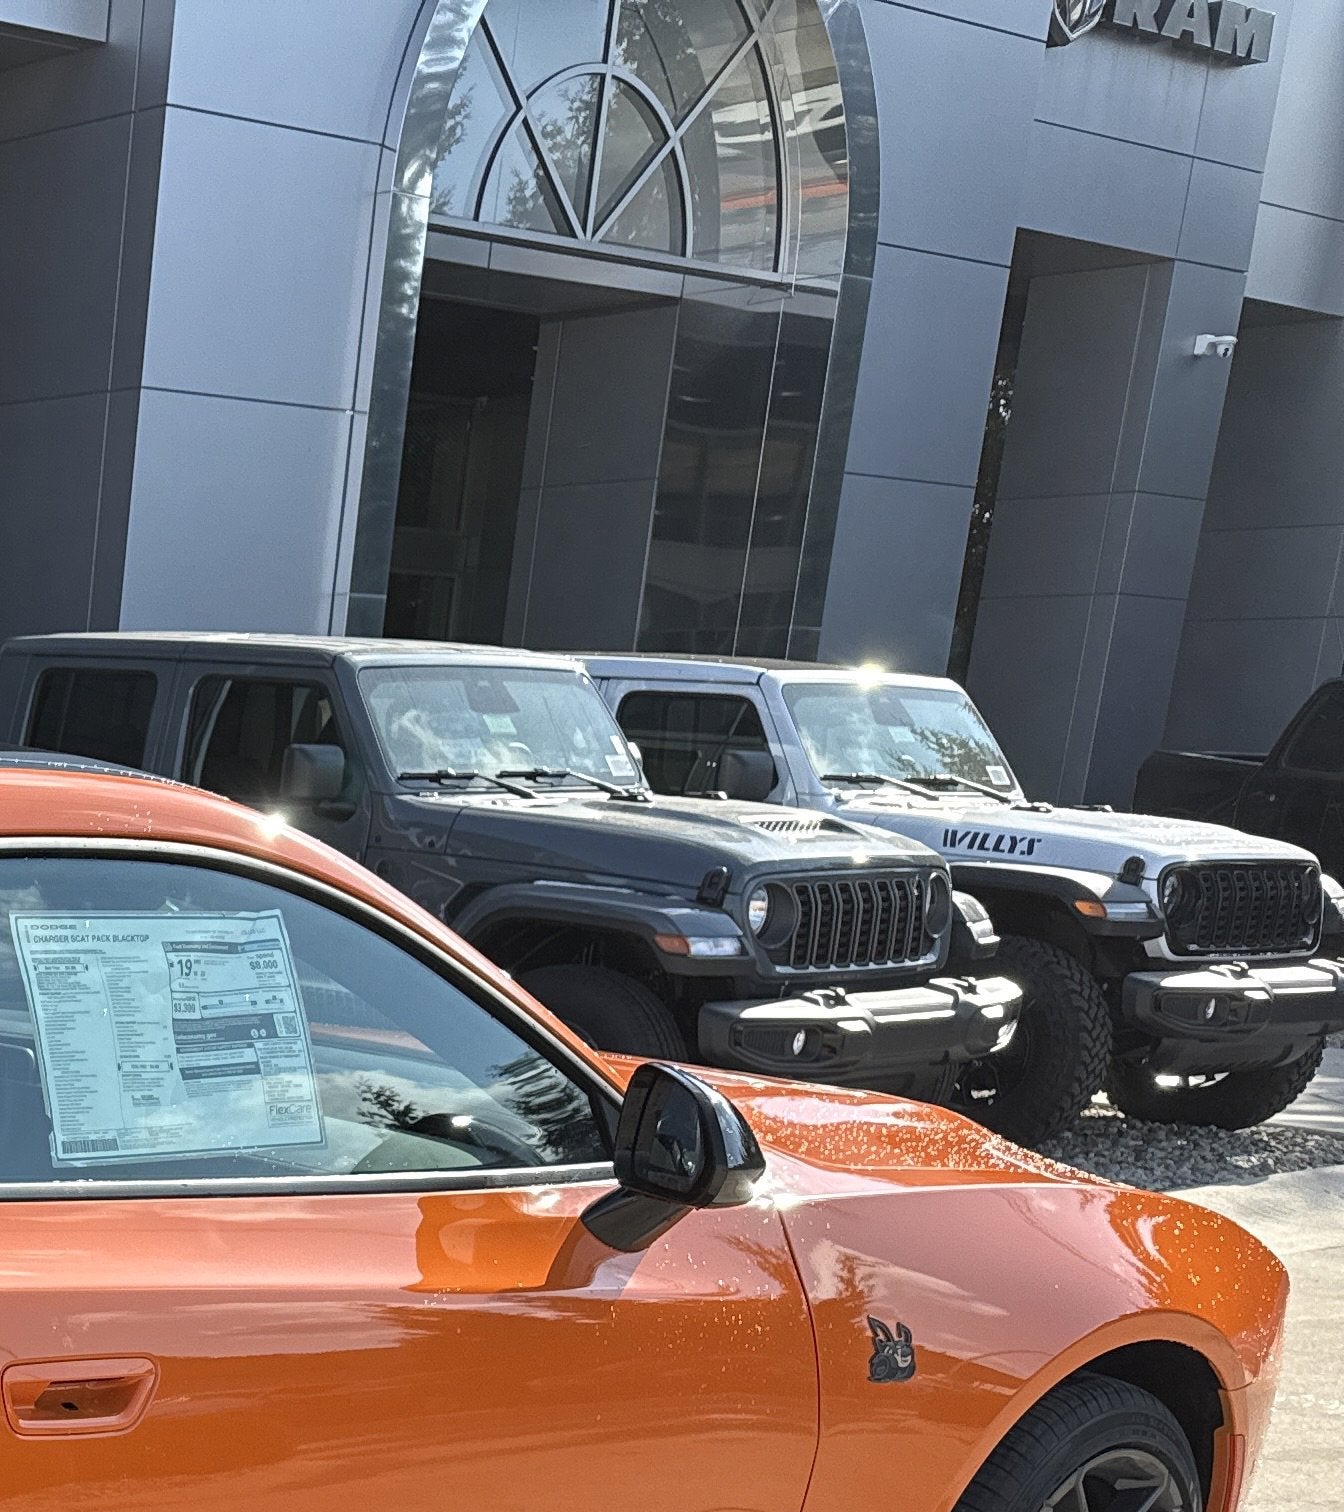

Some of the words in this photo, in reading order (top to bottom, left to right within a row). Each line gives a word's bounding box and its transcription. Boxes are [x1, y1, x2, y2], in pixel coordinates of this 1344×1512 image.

[943, 829, 1042, 856] WILLYS
[33, 935, 69, 944] CHARGER
[92, 934, 111, 942] PACK
[112, 934, 150, 943] BLACKTOP
[177, 958, 193, 977] 19
[269, 1103, 312, 1115] FlexCare
